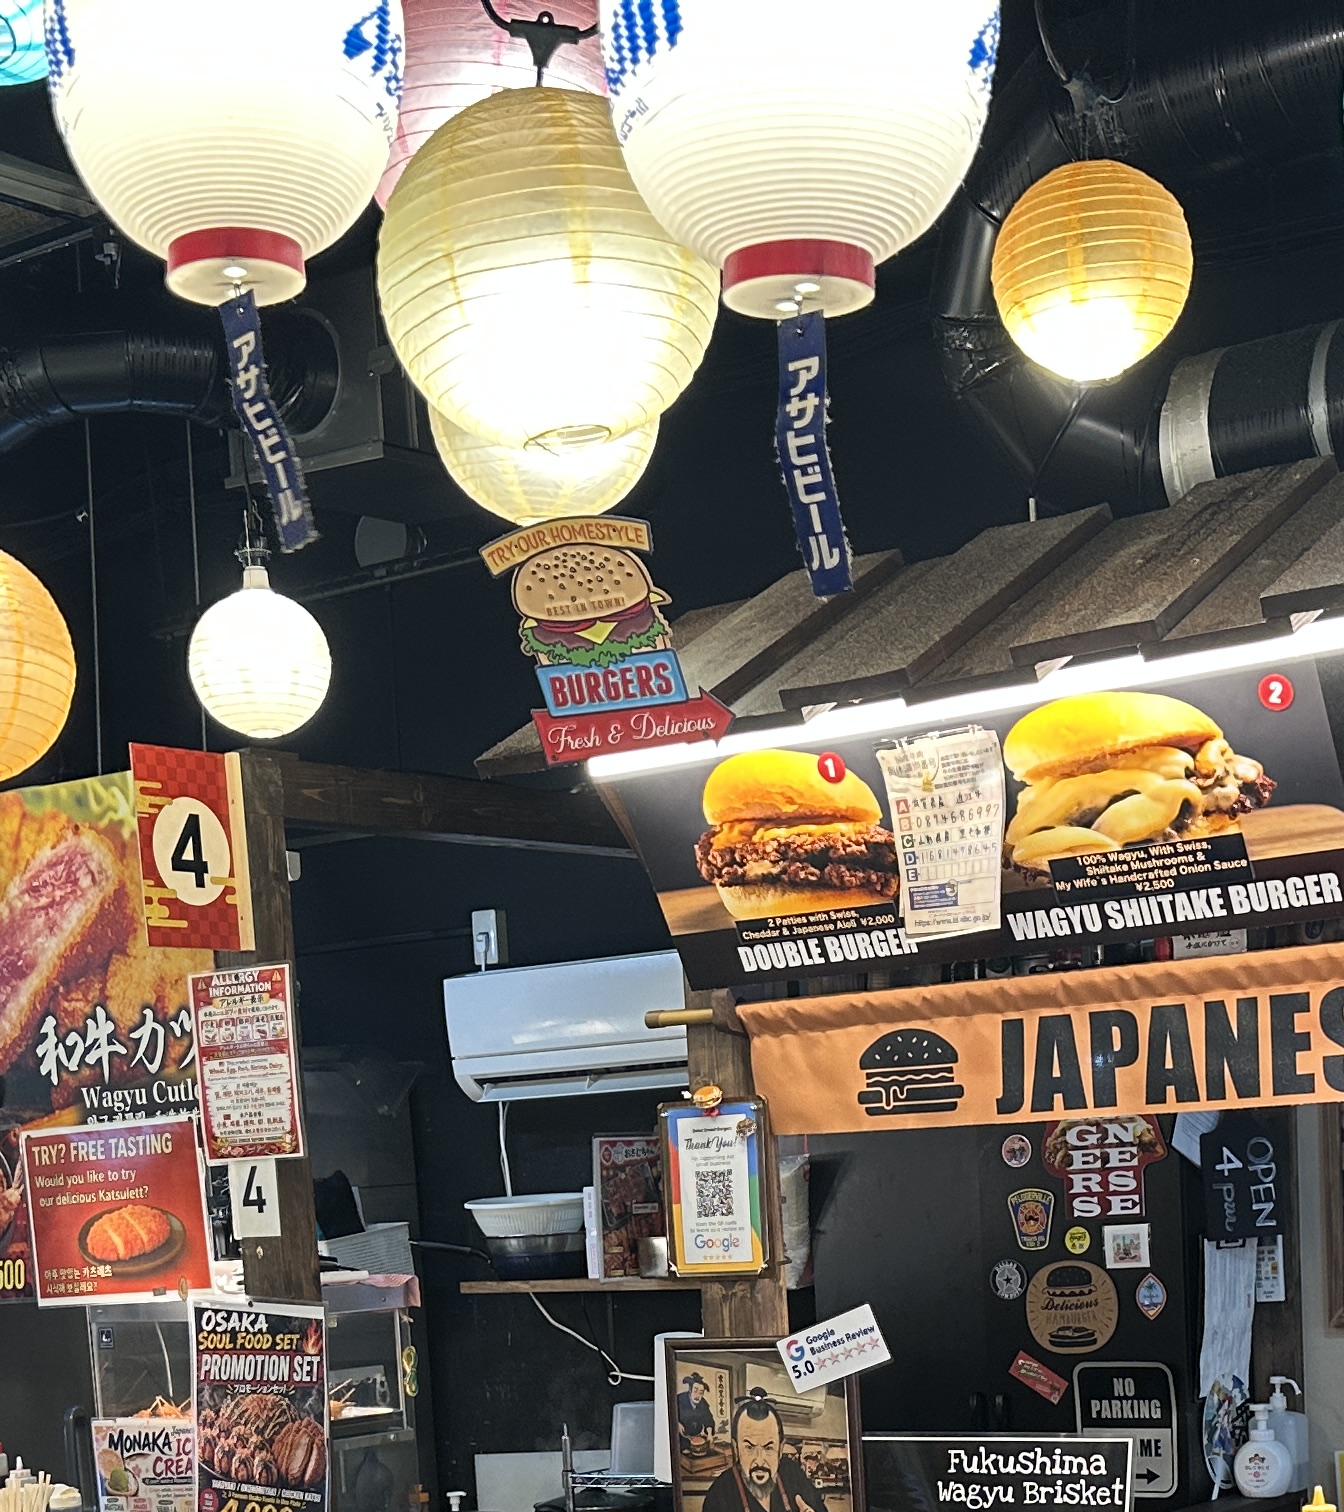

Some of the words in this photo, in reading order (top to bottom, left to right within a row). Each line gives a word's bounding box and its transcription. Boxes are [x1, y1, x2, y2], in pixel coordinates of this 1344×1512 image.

[232, 334, 303, 529] アサヒビール
[787, 359, 841, 571] アサヒビール
[488, 544, 516, 567] TRY
[516, 533, 550, 553] OUR
[551, 522, 645, 546] HOMESTYLE
[546, 604, 572, 617] BEST
[549, 662, 674, 708] BURGERS
[1268, 679, 1284, 704] 2
[548, 725, 602, 753] Fresh
[608, 724, 624, 744] &
[631, 712, 716, 740] Delicious
[170, 813, 208, 889] 4
[1135, 877, 1175, 892] ¥2,500
[1006, 902, 1103, 942] WAGYU
[1104, 887, 1227, 930] SHIITAKE
[1228, 872, 1343, 914] BURGER
[737, 937, 826, 972] DOUBLE
[208, 981, 272, 998] INFORMATION
[211, 970, 260, 987] ALLERGY
[81, 1086, 148, 1112] Wagyu
[32, 1143, 66, 1167] TRY?
[70, 1138, 105, 1163] FREE
[109, 1132, 173, 1159] TASTING
[35, 1172, 65, 1189] Would
[66, 1174, 86, 1191] you
[86, 1170, 105, 1184] like
[120, 1168, 136, 1184] try
[242, 1166, 266, 1215] 4
[1246, 1137, 1277, 1228] OPEN
[56, 1190, 97, 1206] delicious
[98, 1186, 149, 1202] Katsulett?
[694, 1233, 740, 1252] Google
[1041, 1298, 1098, 1311] Delicious
[201, 1310, 269, 1333] OSAKA
[198, 1332, 233, 1350] SOUL
[236, 1332, 272, 1350] FOOD
[275, 1333, 301, 1350] SET
[806, 1327, 836, 1345] Google
[200, 1353, 291, 1382] PROMOTION
[293, 1356, 321, 1383] SET
[791, 1359, 815, 1379] 5.0
[1112, 1377, 1135, 1396] NO
[1091, 1399, 1161, 1418] PARKING
[108, 1427, 173, 1461] MONAKA
[947, 1448, 1108, 1477] Fukushima
[937, 1481, 1014, 1509] Wagyu
[1023, 1477, 1124, 1506] Brisket
